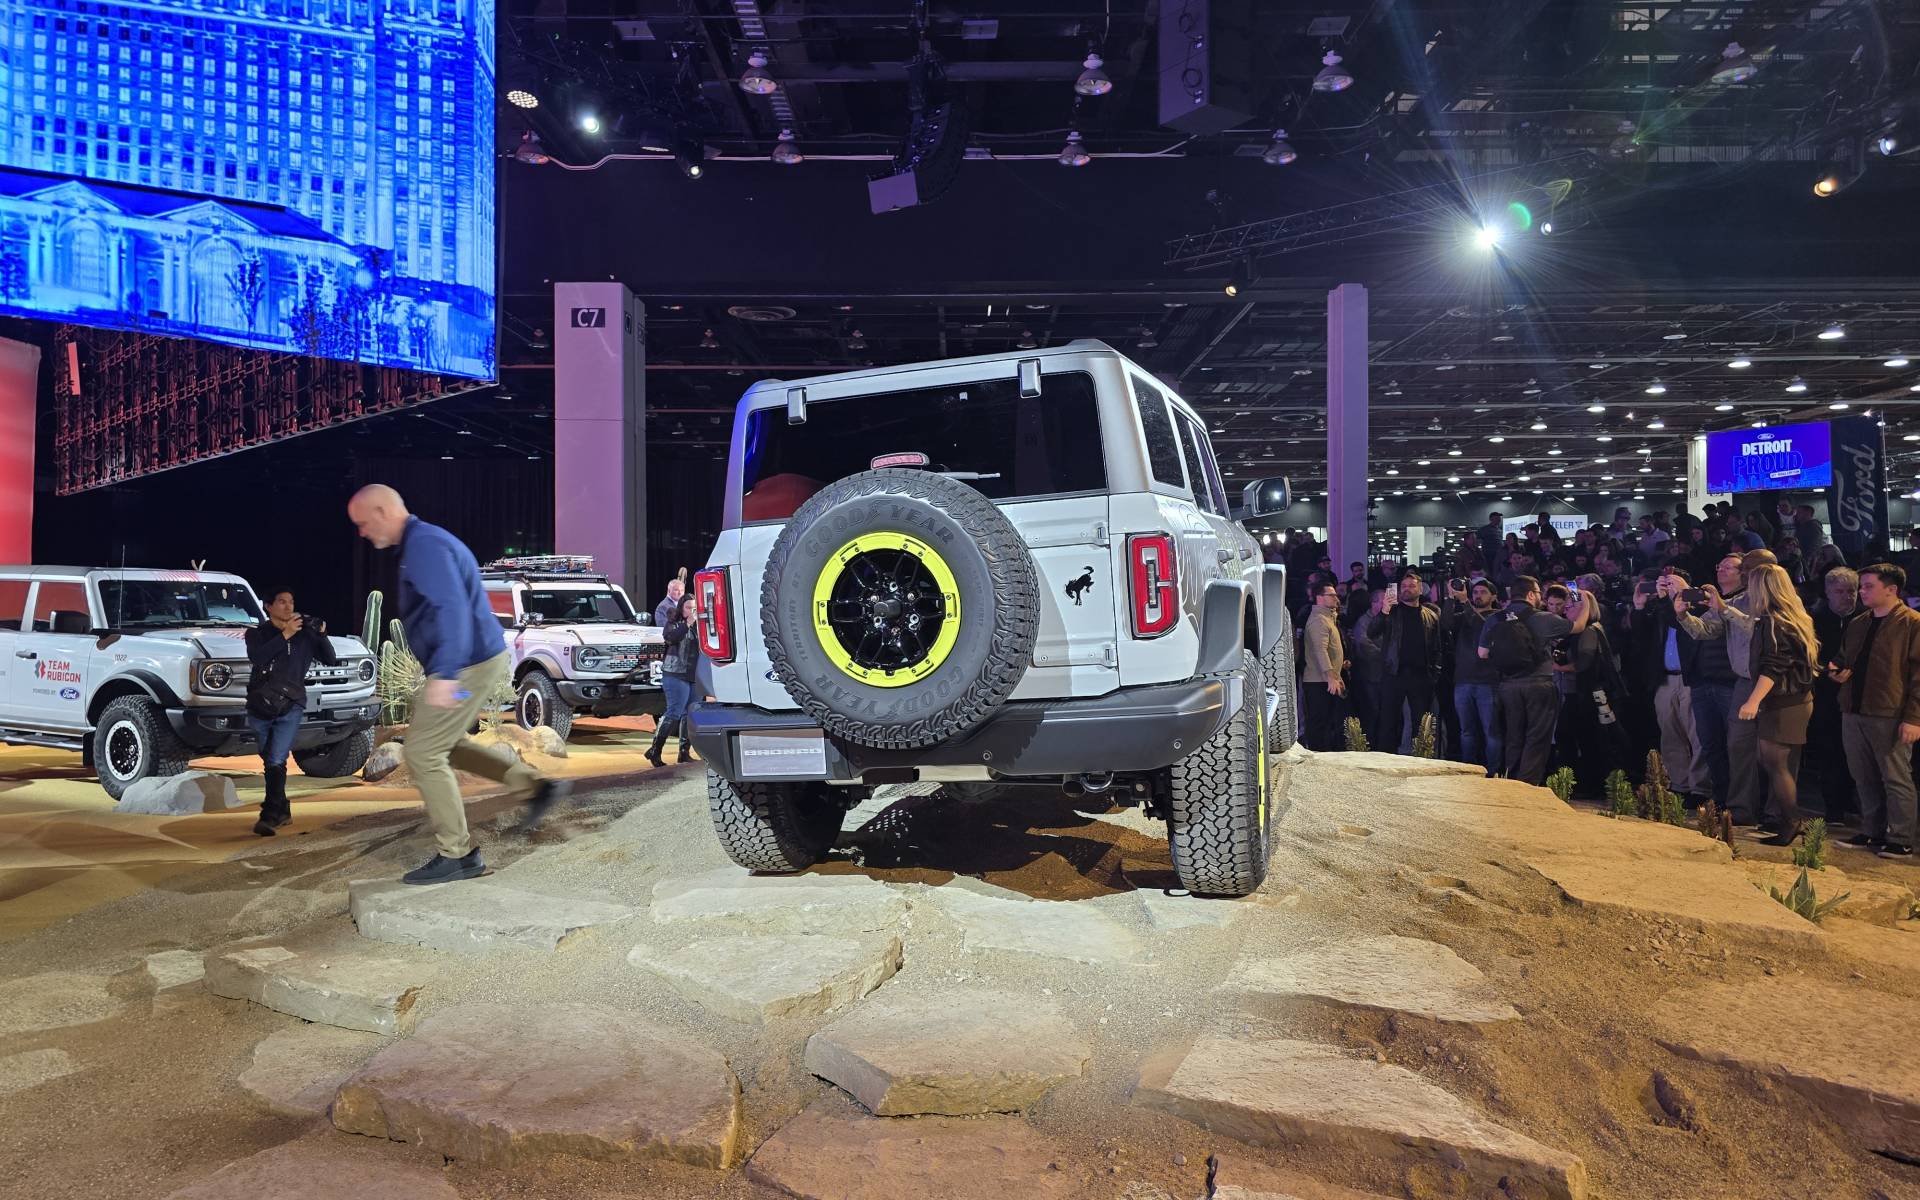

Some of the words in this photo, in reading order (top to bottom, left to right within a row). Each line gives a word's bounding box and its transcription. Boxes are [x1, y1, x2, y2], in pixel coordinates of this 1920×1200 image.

[577, 308, 599, 327] C7
[1741, 439, 1793, 456] DETROIT
[1733, 451, 1803, 475] PROUD
[1834, 443, 1875, 537] Ford
[1551, 521, 1574, 529] TELER
[48, 660, 70, 671] TEAM
[47, 671, 81, 682] RUBICON
[62, 688, 78, 699] Ford
[744, 748, 822, 756] BRONCO
